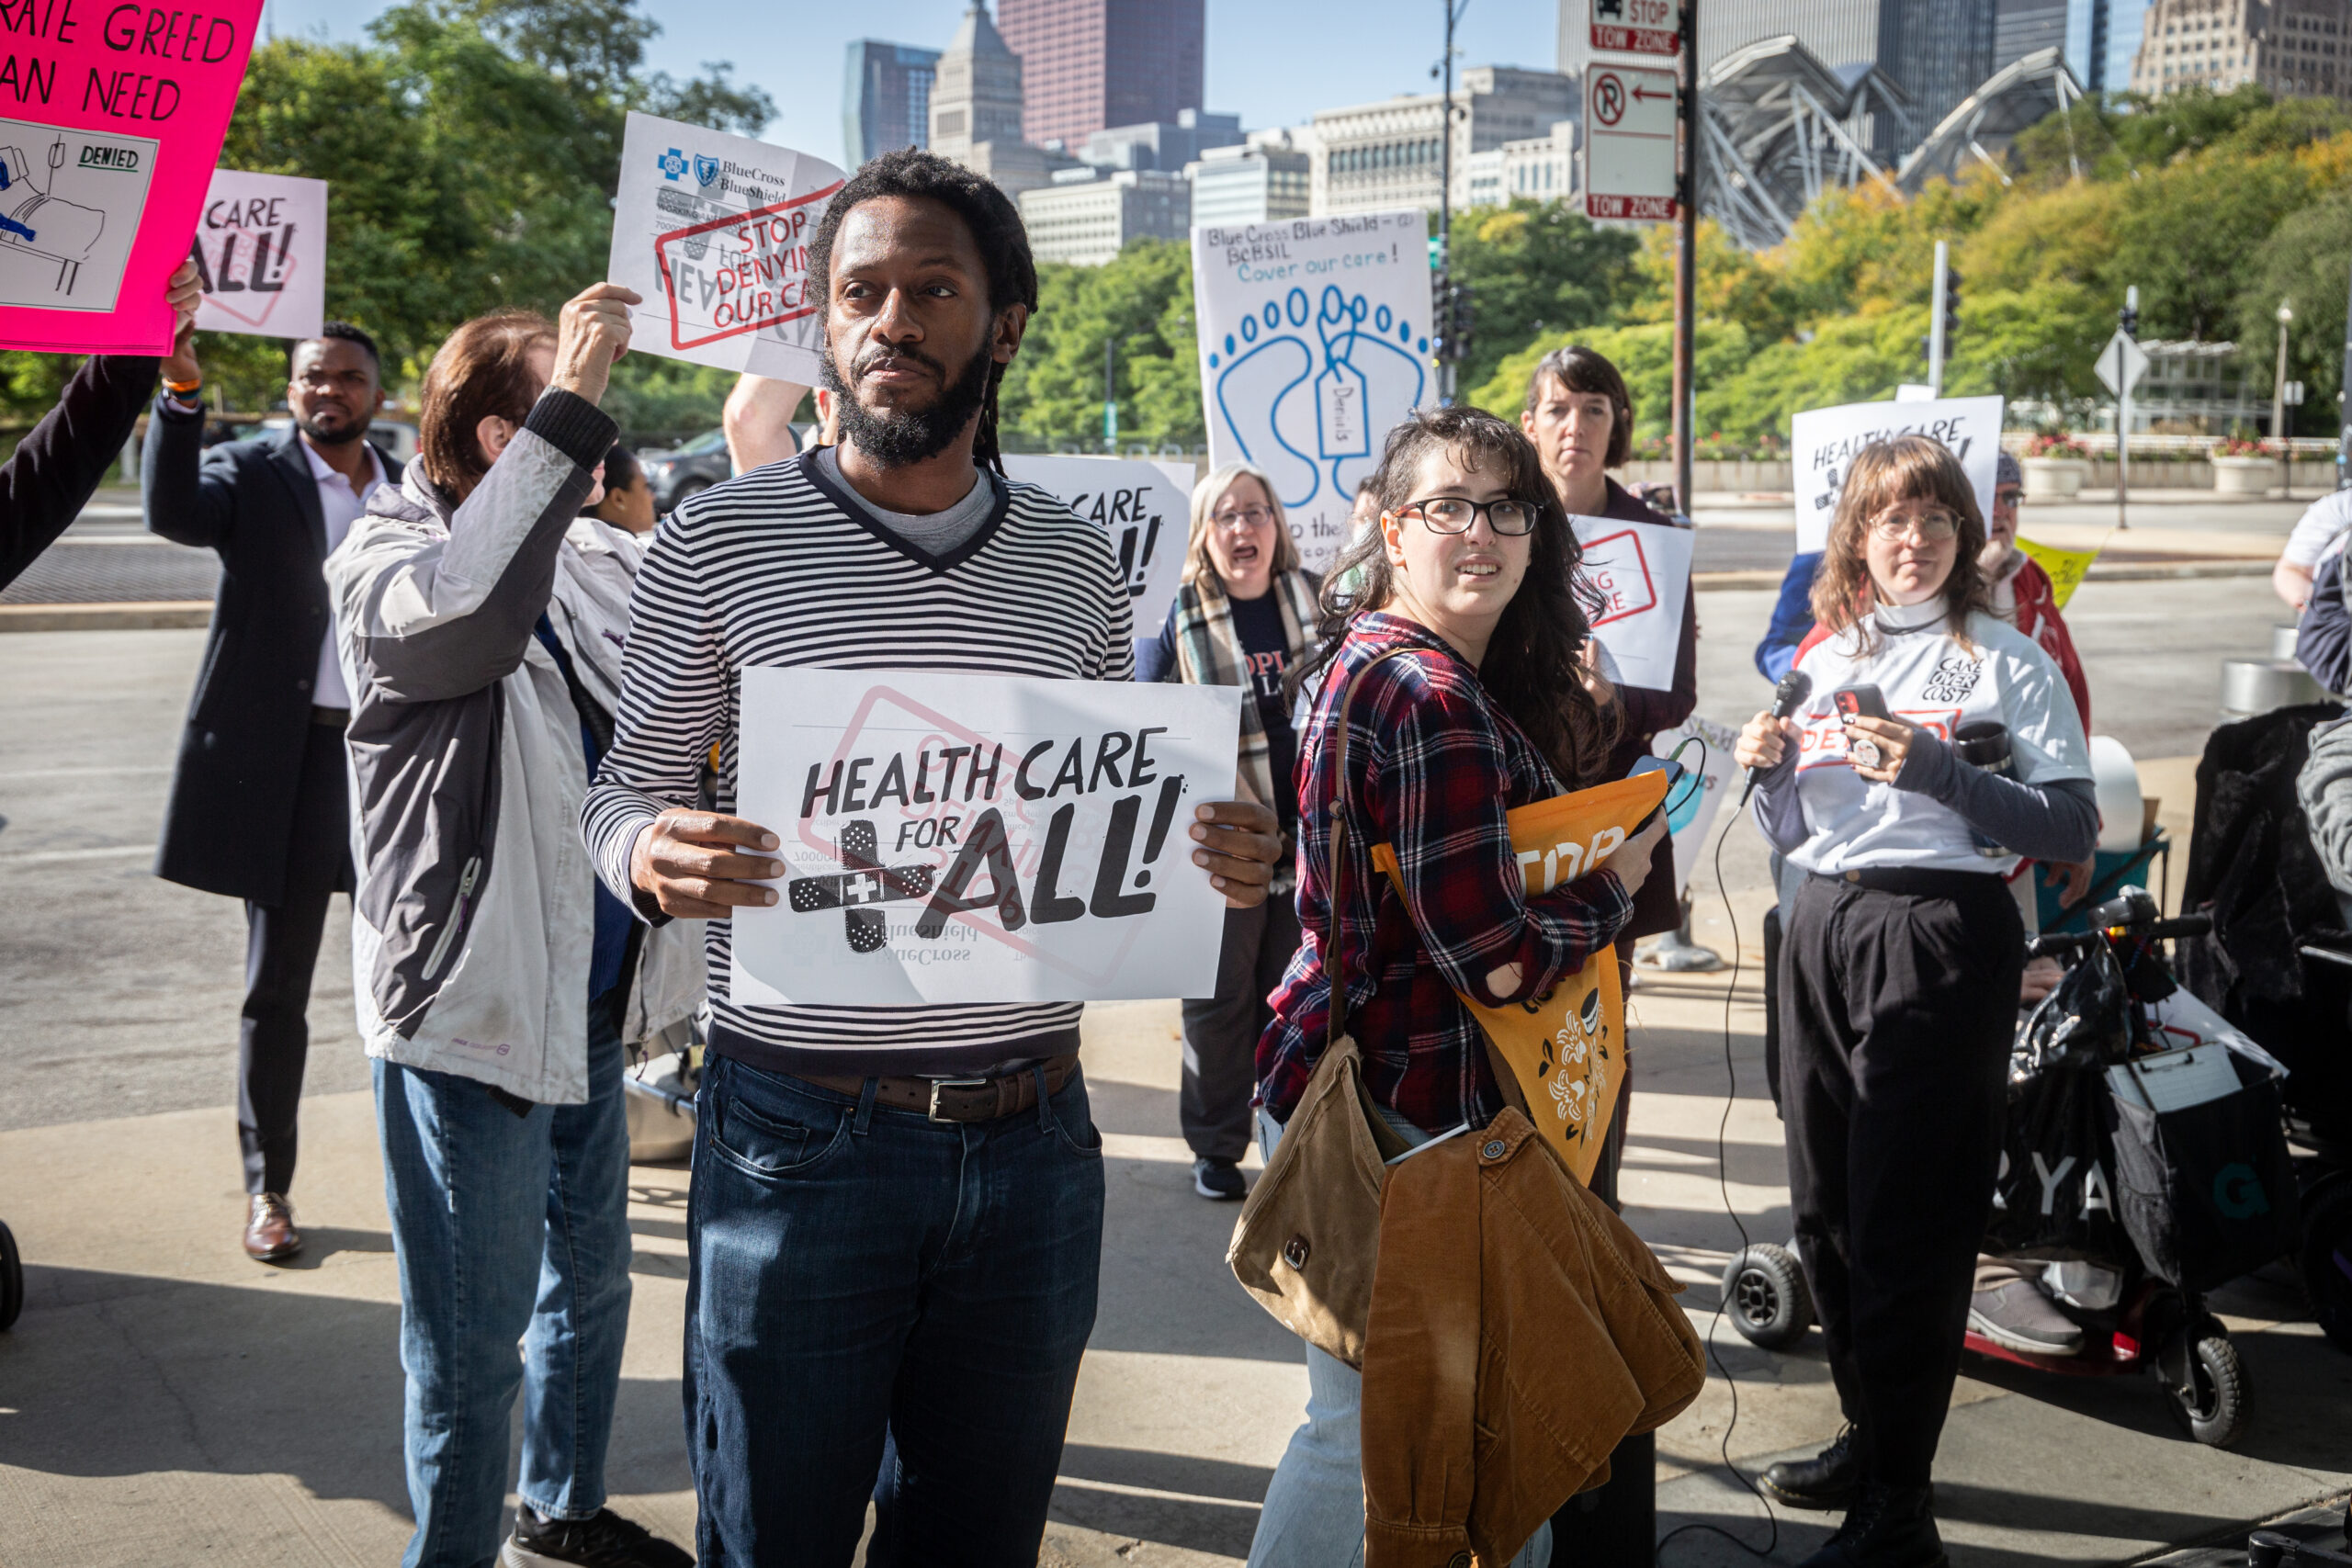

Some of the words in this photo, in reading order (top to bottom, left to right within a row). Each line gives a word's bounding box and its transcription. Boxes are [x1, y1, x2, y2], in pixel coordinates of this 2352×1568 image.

[1630, 0, 1669, 24] STOP
[104, 4, 235, 63] GREED
[1595, 26, 1627, 49] TOW
[1634, 29, 1674, 51] ZONE
[82, 67, 181, 121] NEED
[80, 145, 139, 168] DENIED
[722, 160, 786, 186] BlueCross
[720, 178, 786, 203] BlueShield
[206, 197, 286, 229] CARE
[1591, 196, 1623, 215] TOW
[1629, 197, 1670, 218] ZONE
[738, 211, 806, 254] STOP
[1208, 228, 1241, 246] Blue
[1293, 220, 1326, 241] Blue
[717, 245, 809, 296] DENYIN
[1238, 263, 1298, 282] Cover
[1306, 258, 1339, 275] our
[714, 290, 774, 328] OUR
[1939, 657, 1985, 673] CARE
[1931, 671, 1980, 689] OVER
[800, 742, 1002, 818] HEALTH
[1013, 727, 1168, 801] CARE
[895, 816, 961, 852] FOR
[915, 773, 1188, 940] ALL!
